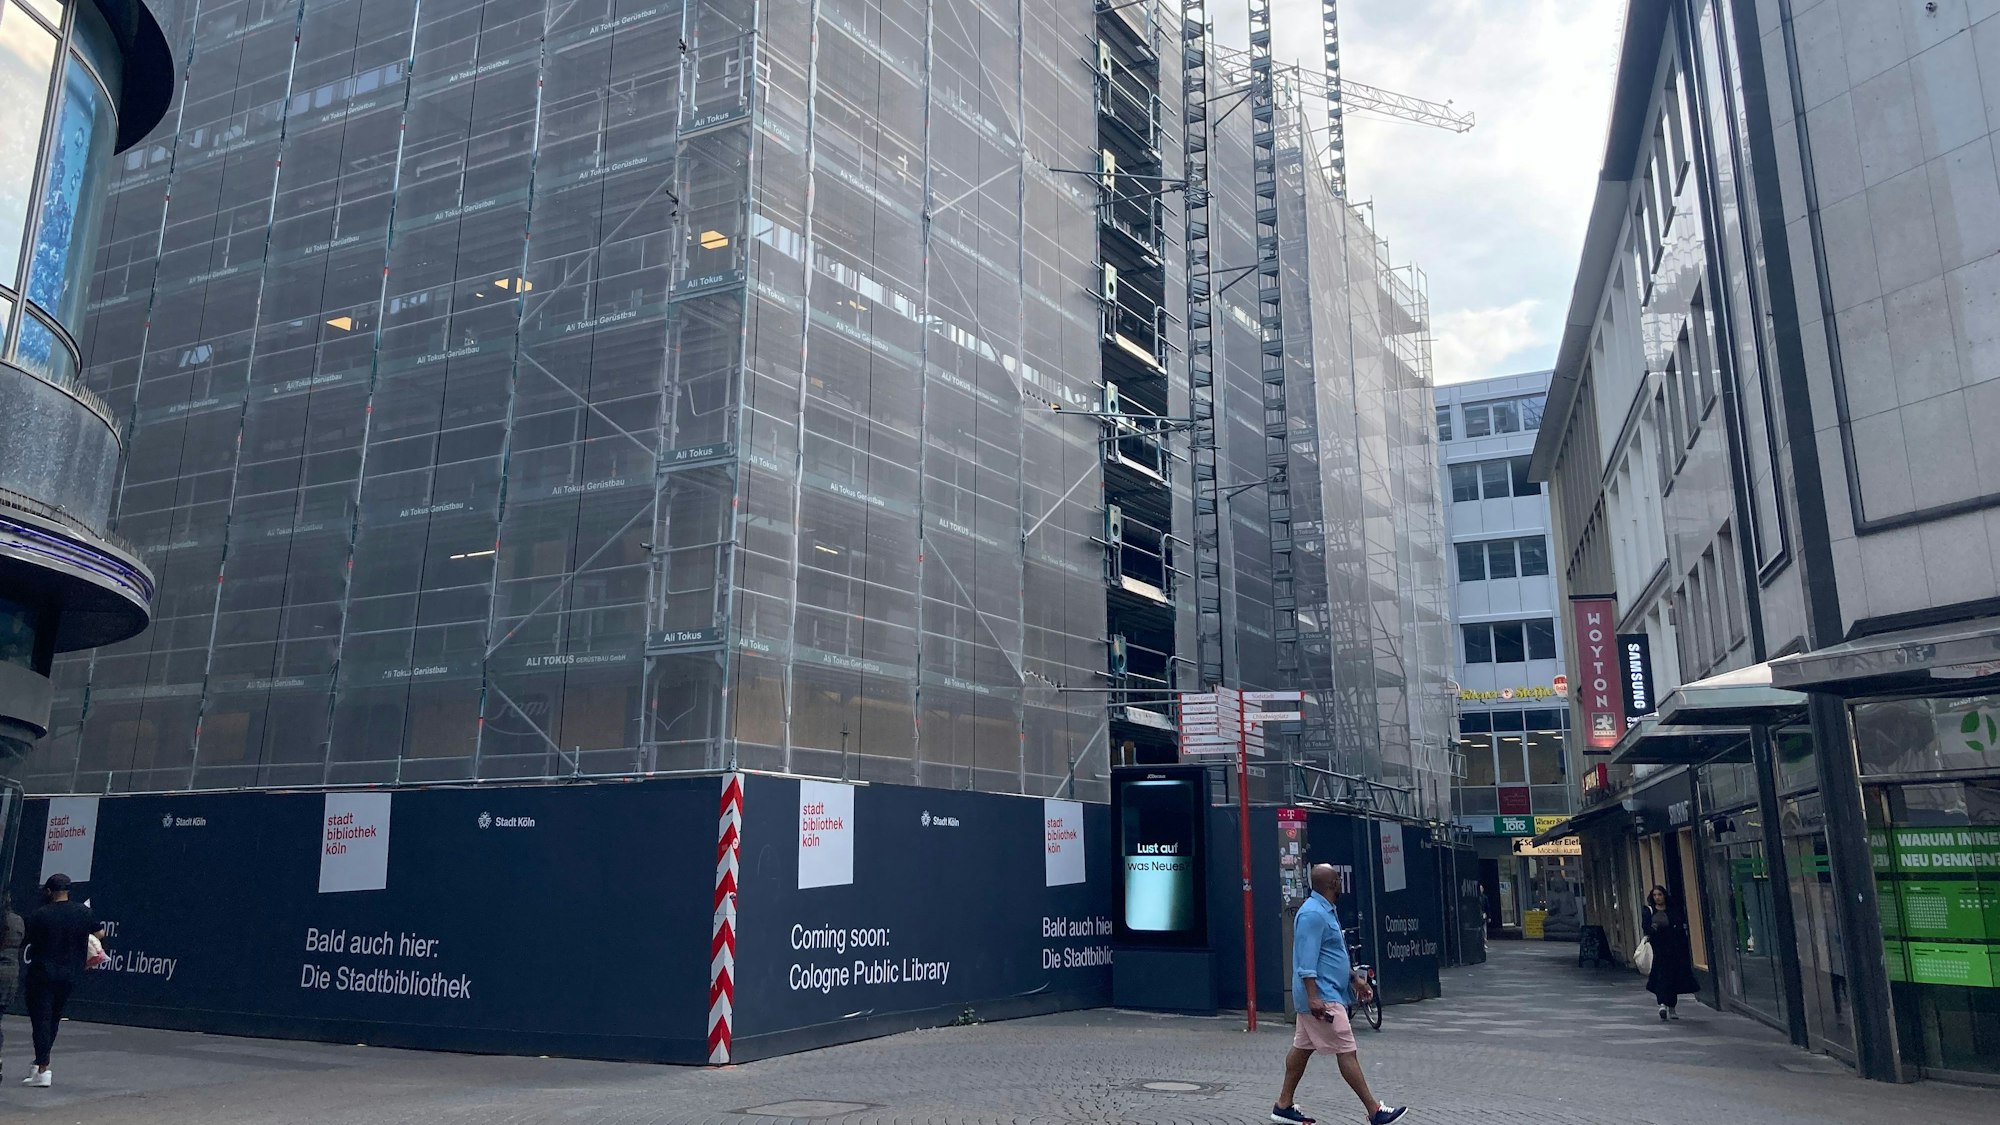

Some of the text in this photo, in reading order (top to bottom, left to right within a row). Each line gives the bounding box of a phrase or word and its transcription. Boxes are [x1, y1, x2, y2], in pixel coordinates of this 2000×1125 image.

[694, 112, 729, 128] Ali Tokus
[578, 172, 589, 181] Ali
[611, 156, 648, 171] Gerüstbau
[687, 273, 723, 288] Ali Tokus
[566, 323, 576, 332] Ali
[577, 319, 597, 329] Tokus
[676, 447, 713, 460] Ali Tokus
[749, 454, 778, 472] Ali Tokus
[552, 478, 625, 495] Ali Tokus Gerüstbau
[830, 482, 839, 491] Ali
[400, 508, 410, 518] Ali
[430, 501, 464, 513] Gerüstbau
[664, 631, 702, 642] Ali Tokus
[739, 637, 769, 652] Ali Tokus
[526, 656, 541, 667] ALI
[543, 654, 575, 666] TOKUS
[1587, 612, 1608, 708] WOYTON
[1627, 643, 1646, 709] SAMSUNG
[802, 802, 825, 815] stadt
[50, 814, 69, 826] stadt
[175, 817, 192, 826] Stadt
[328, 812, 354, 826] stadt
[495, 816, 535, 827] Stadt Köln
[802, 817, 843, 831] bibliothek
[933, 816, 960, 827] Stadt Köln
[1047, 817, 1063, 828] stadt
[48, 825, 86, 839] bibliothek
[327, 825, 377, 841] bibliothek
[1047, 828, 1077, 841] bibliothek
[46, 840, 63, 851] köln
[802, 833, 820, 847] köln
[1897, 832, 1955, 847] WARUM
[325, 842, 347, 855] köln
[1047, 842, 1061, 854] köln
[1137, 842, 1178, 854] Lust auf
[1127, 862, 1150, 871] was
[1901, 853, 1930, 867] NEU
[1042, 916, 1112, 938] Bald auch hier
[305, 927, 440, 958] Bald auch hier:
[791, 923, 890, 954] Coming soon:
[1042, 945, 1113, 969] Die Stadtbiblio
[126, 950, 177, 981] Library
[300, 963, 472, 999] Die Stadtbibliothek
[789, 957, 950, 994] Cologne Public Library
